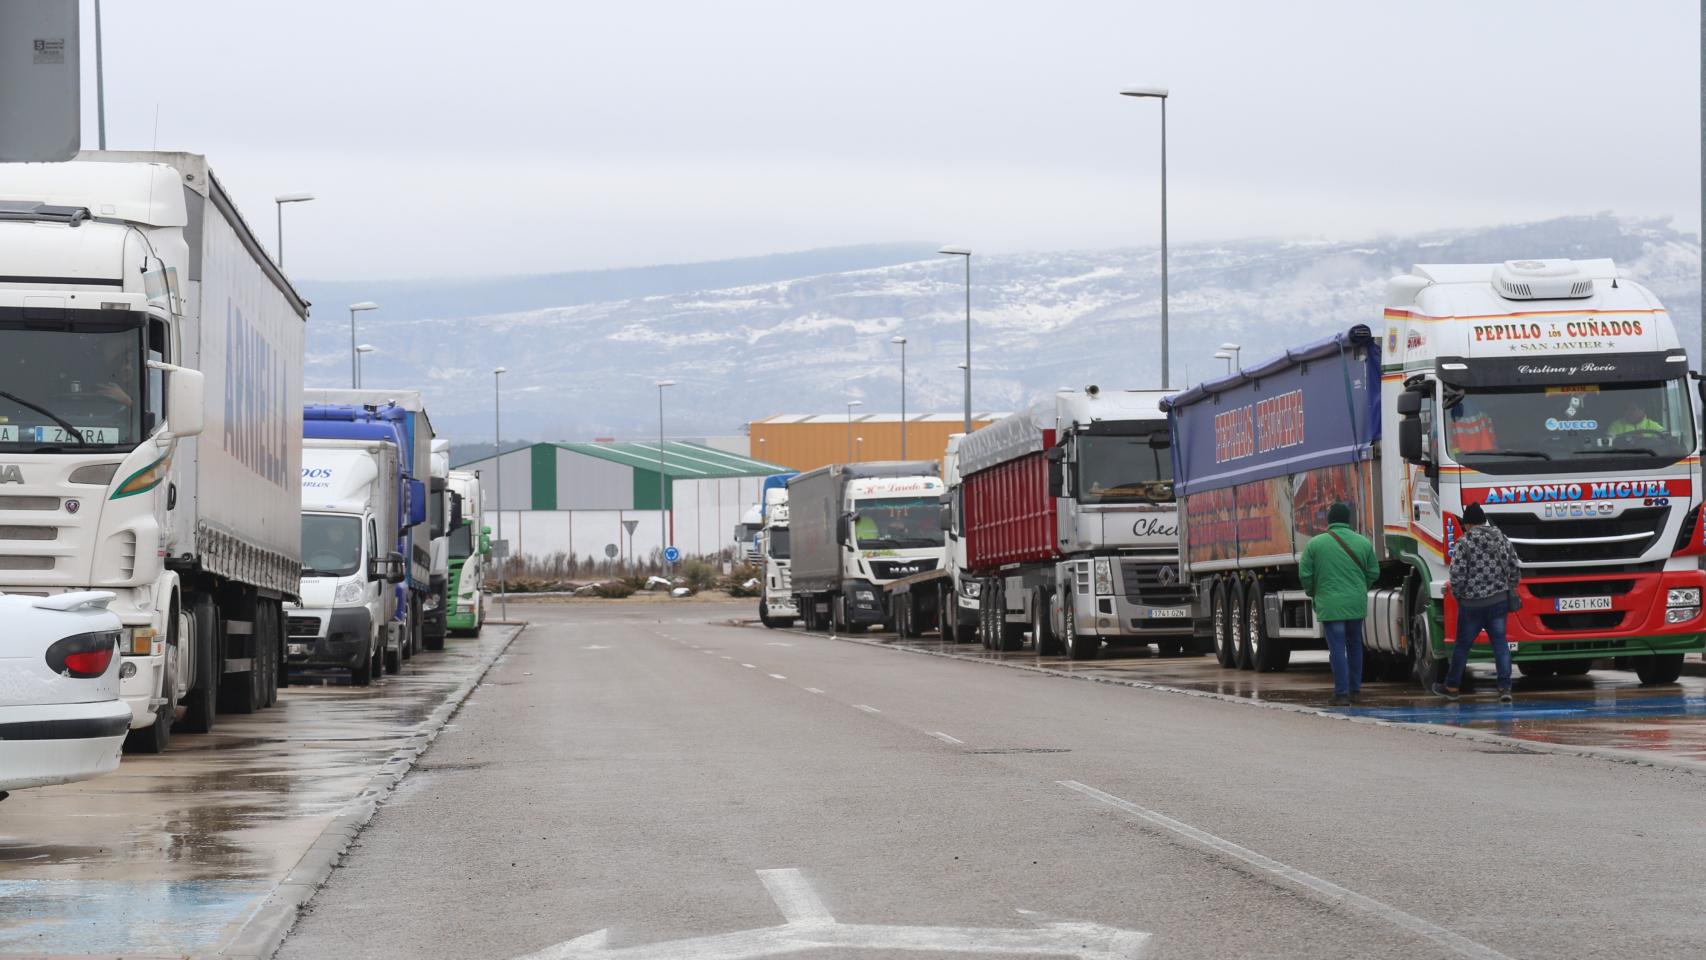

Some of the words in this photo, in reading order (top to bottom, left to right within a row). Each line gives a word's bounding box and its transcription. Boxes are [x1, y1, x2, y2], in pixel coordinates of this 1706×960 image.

[1474, 323, 1541, 341] PEPILLO
[1549, 330, 1561, 338] LOS
[1567, 318, 1643, 338] CUÑADOS
[1520, 342, 1547, 350] SAN
[1552, 341, 1602, 350] JAVIER
[1518, 364, 1566, 374] Cristina
[1559, 420, 1598, 430] IVECO
[54, 428, 105, 443] ZARA
[1485, 484, 1582, 503] ANTONIO
[1591, 480, 1671, 499] MIGUEL
[1544, 501, 1614, 518] IVECO
[889, 566, 919, 574] MAN
[1561, 599, 1587, 610] 2461
[1590, 598, 1610, 609] KGN
